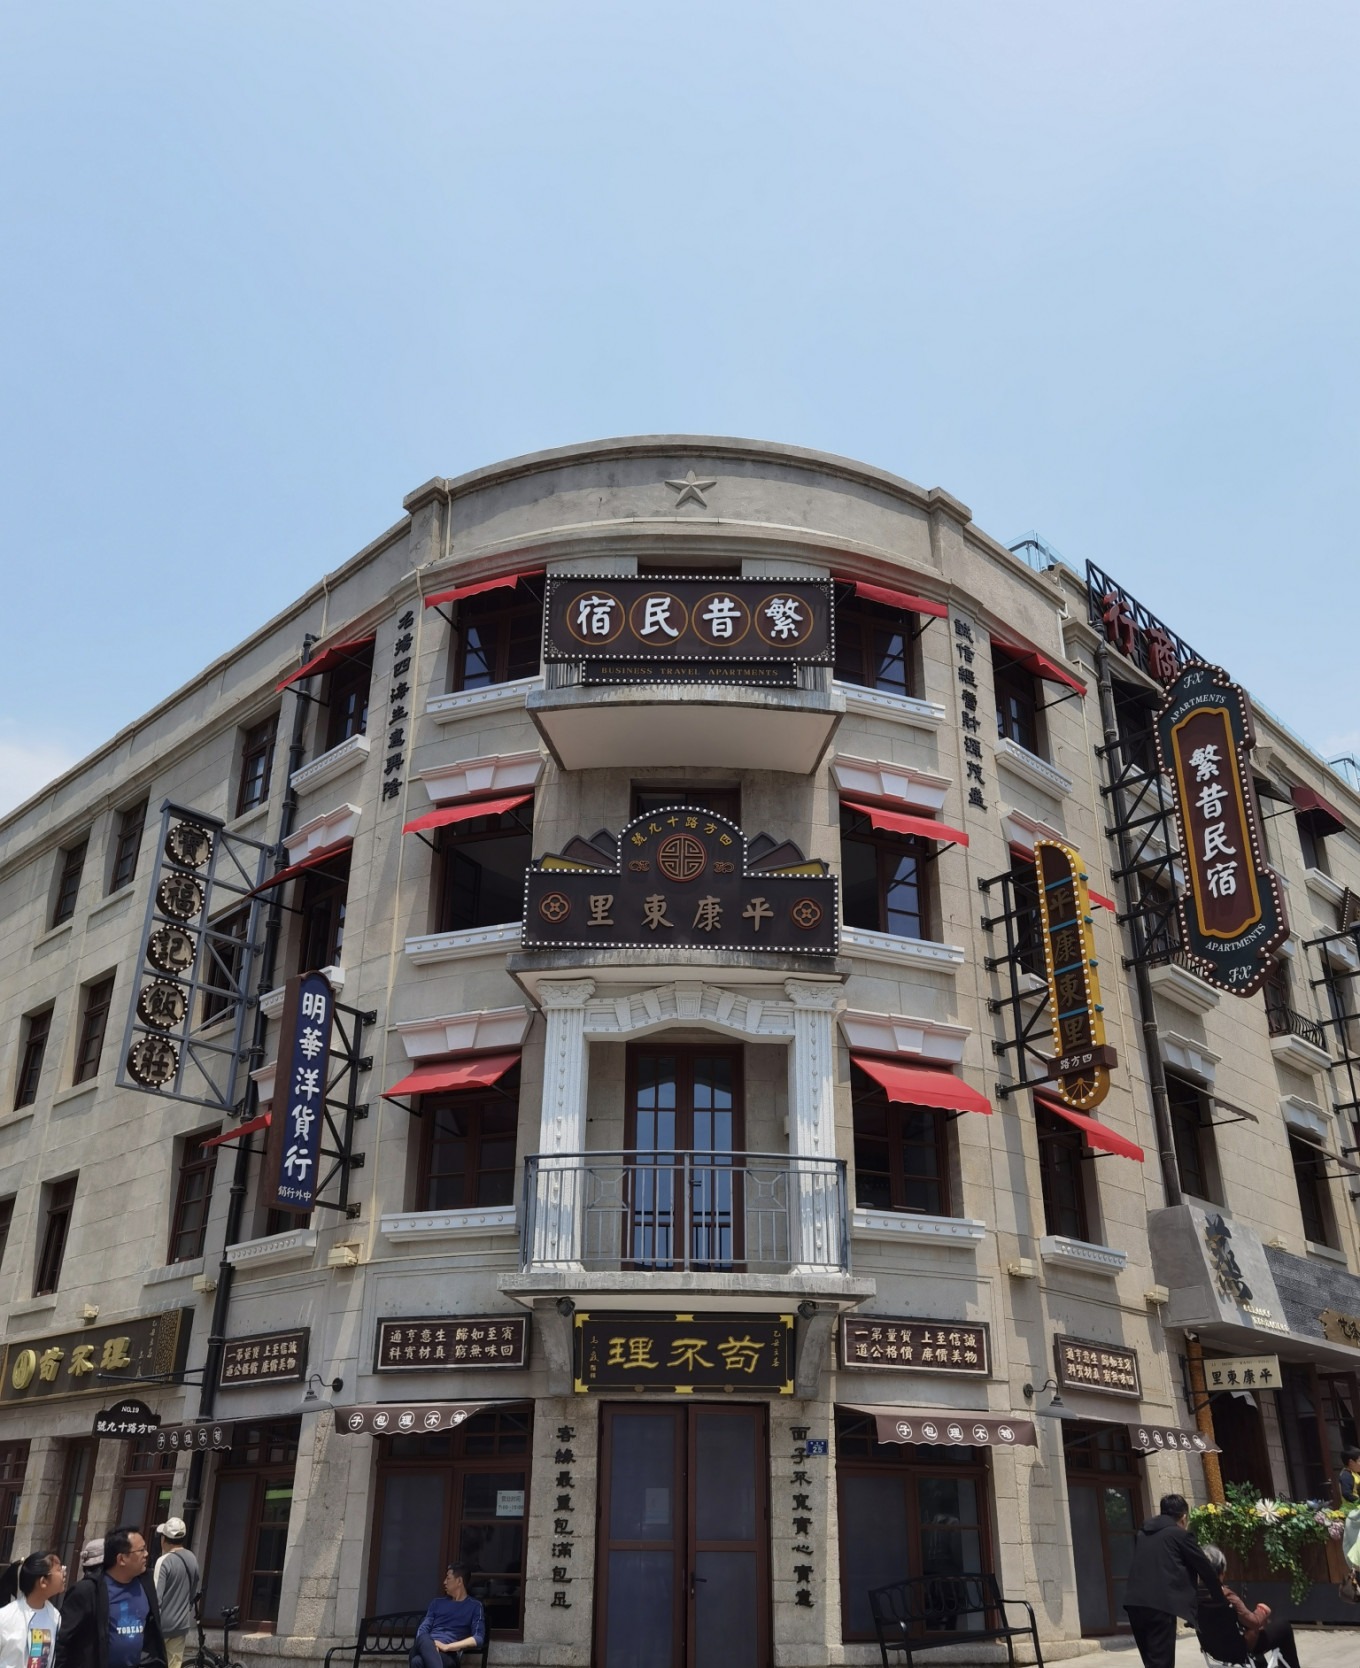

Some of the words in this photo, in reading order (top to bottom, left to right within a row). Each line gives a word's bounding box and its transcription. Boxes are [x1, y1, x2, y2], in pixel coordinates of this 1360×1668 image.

[577, 596, 803, 639] 繁昔民宿
[601, 667, 653, 675] BUSINESS
[660, 667, 700, 676] TRAVEL
[708, 667, 779, 677] APARTMENTS
[1169, 693, 1226, 723] APARTMENTS
[1188, 743, 1238, 899] 繁昔民宿
[586, 894, 774, 932] 平康東里
[1205, 923, 1266, 953] APARTMENTS
[1049, 886, 1088, 1050] 平康東里
[284, 991, 326, 1181] 明華洋貨行
